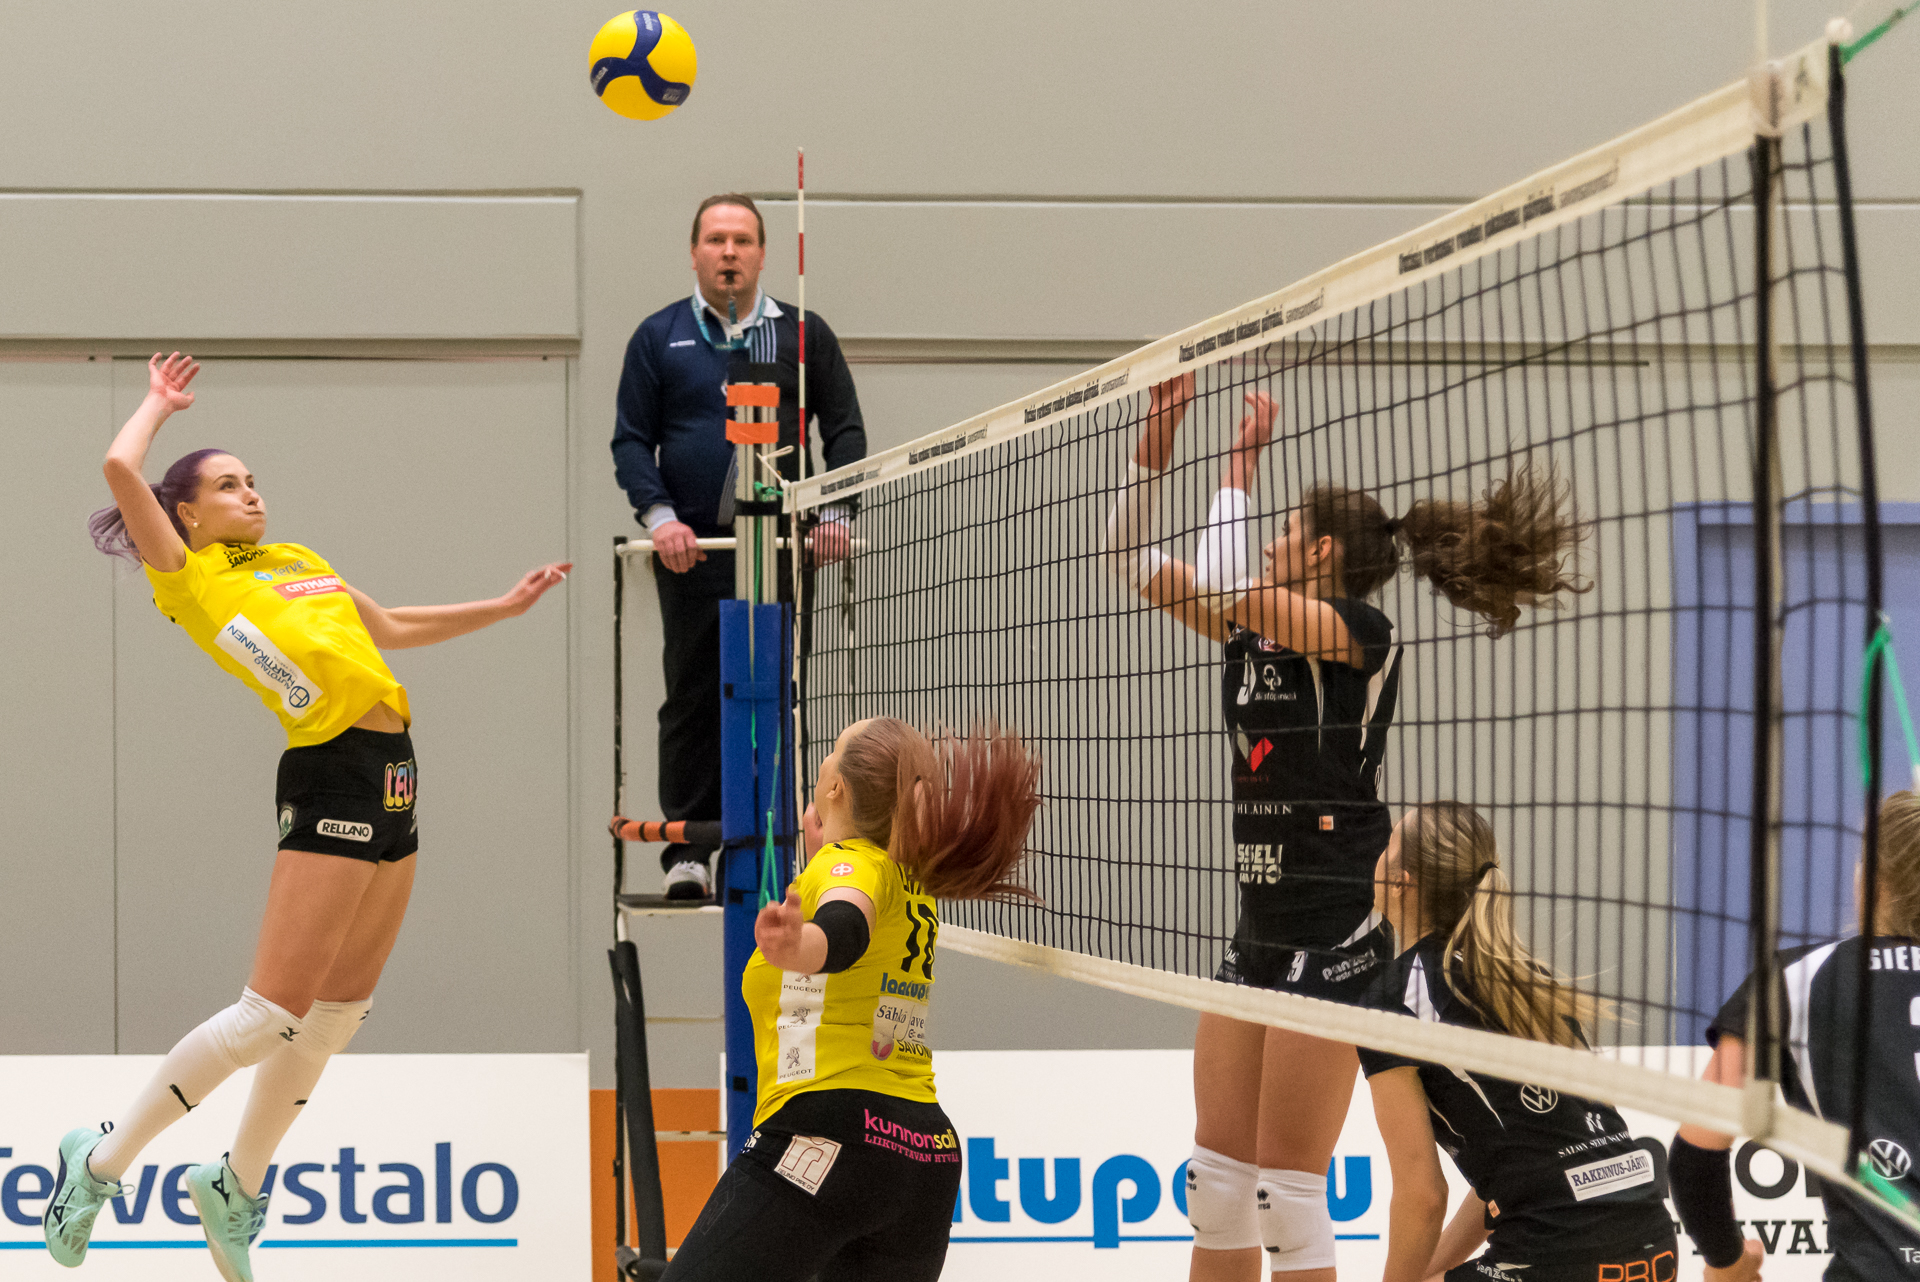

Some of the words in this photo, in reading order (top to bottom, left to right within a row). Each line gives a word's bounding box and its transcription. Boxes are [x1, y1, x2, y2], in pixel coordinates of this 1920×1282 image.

[271, 560, 311, 577] Terve
[227, 625, 296, 687] HARTIKAINEN
[322, 821, 370, 838] RELLANO
[783, 984, 824, 994] PEUGEOT
[779, 1068, 813, 1080] PEUGEOT
[864, 1108, 957, 1150] kunnonsali
[864, 1133, 932, 1163] LIIKUTTAVAN
[0, 1141, 520, 1247] evestalo
[1899, 1247, 1920, 1263] Ta
